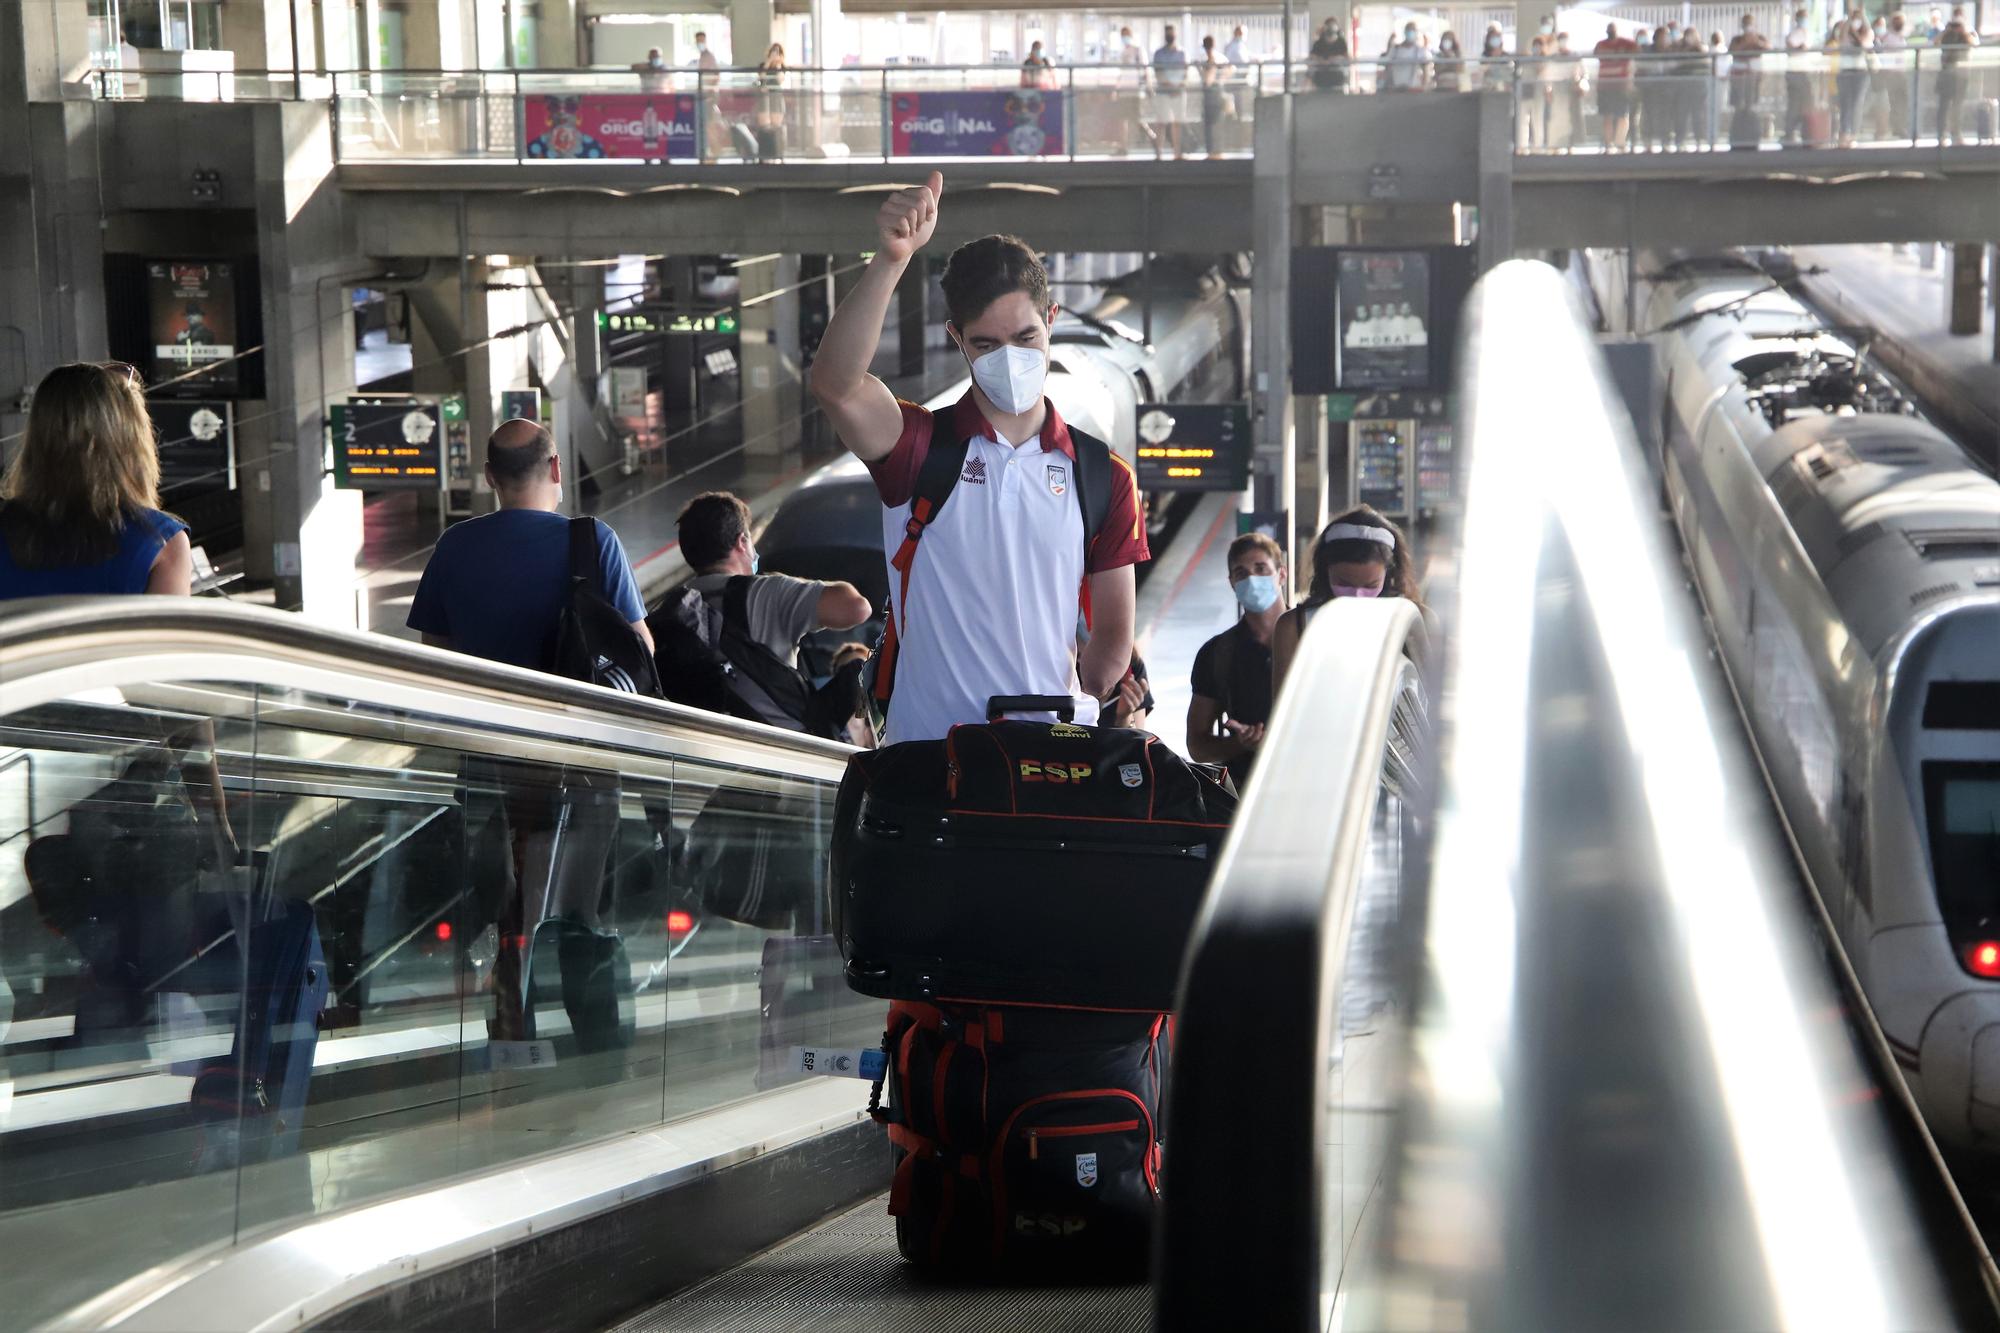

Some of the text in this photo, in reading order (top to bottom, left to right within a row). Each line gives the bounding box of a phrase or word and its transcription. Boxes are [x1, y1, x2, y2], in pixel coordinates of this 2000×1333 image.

[344, 423, 356, 442] 2
[961, 473, 986, 485] luanvi
[1020, 758, 1093, 784] ESP
[803, 1052, 815, 1071] ESP
